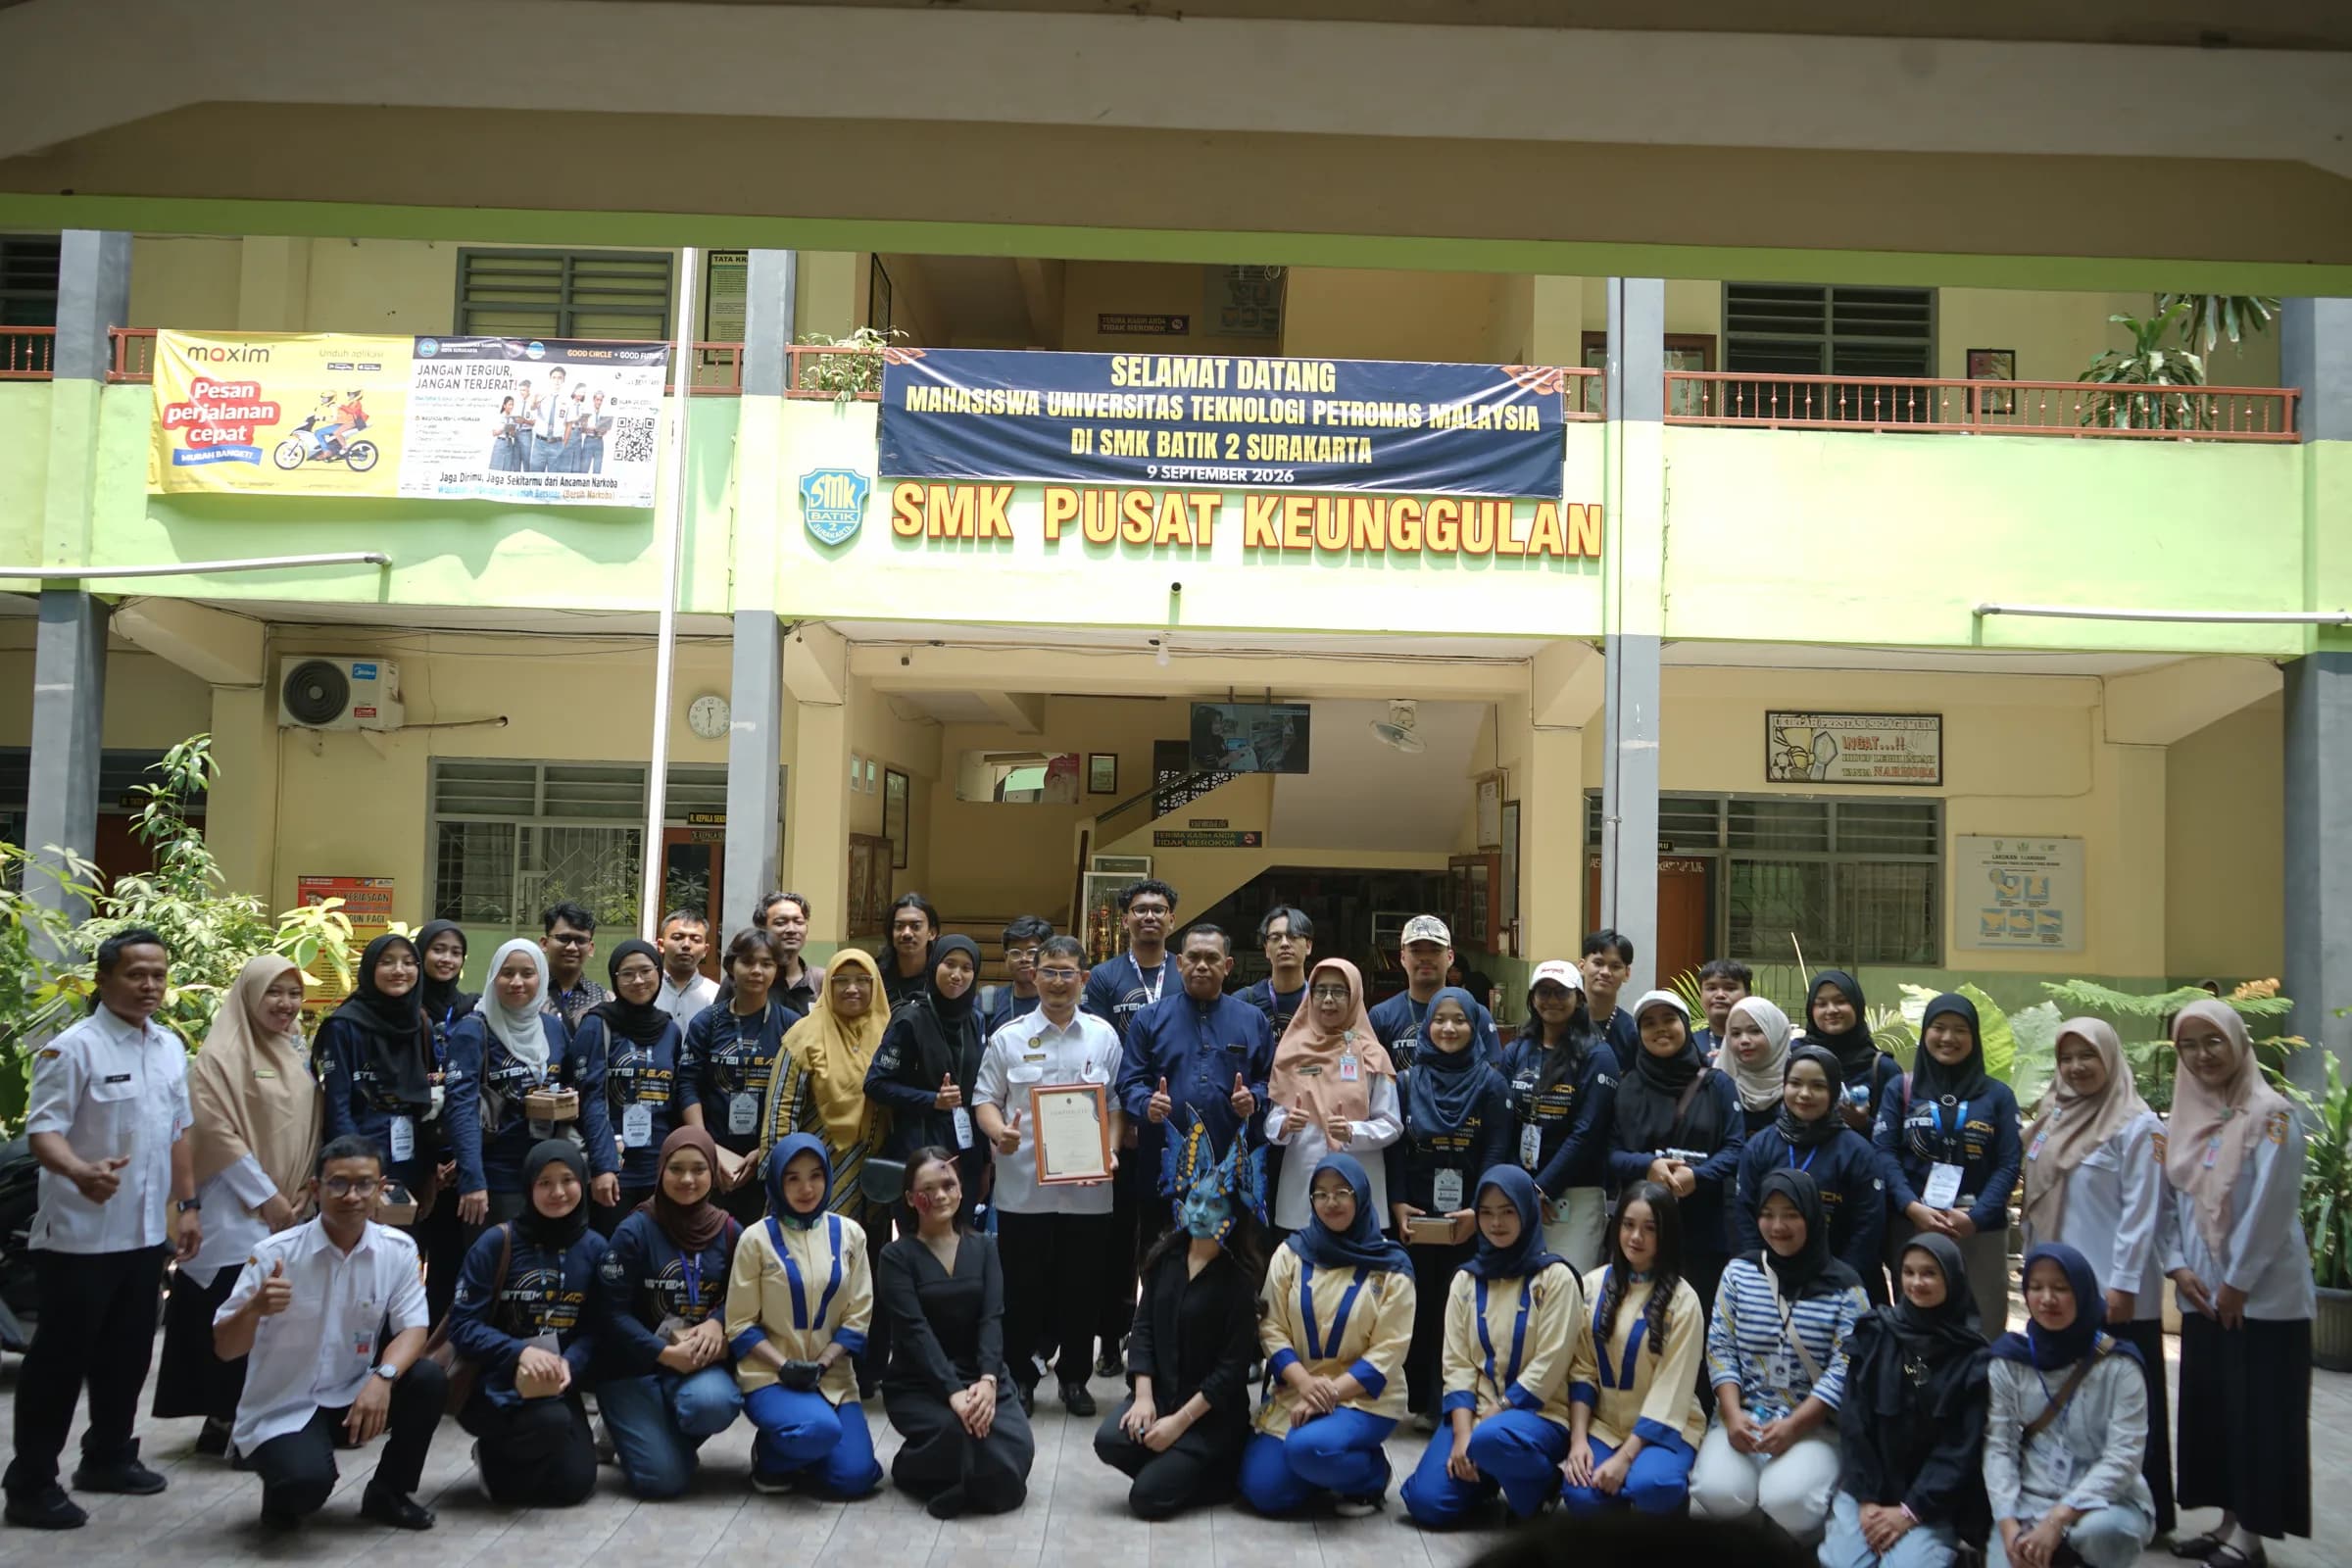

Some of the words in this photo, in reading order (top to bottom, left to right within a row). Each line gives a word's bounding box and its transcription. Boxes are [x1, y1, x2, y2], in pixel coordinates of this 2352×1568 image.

[188, 344, 270, 363] maxim
[319, 349, 348, 359] Unduh
[589, 350, 612, 359] CIRCLE
[619, 351, 640, 360] GOOD
[417, 365, 463, 376] JANGAN
[466, 365, 513, 377] TERGIUR,
[1110, 356, 1230, 391] SELAMAT
[1238, 361, 1337, 393] DATANG
[194, 382, 255, 399] Pesan
[416, 378, 461, 389] JANGAN
[464, 378, 517, 391] TERJERAT!
[168, 401, 274, 423] perjalanan
[906, 385, 1040, 416] MAHASISWA
[1047, 392, 1184, 421] UNIVERSITAS
[1191, 396, 1305, 424] TEKNOLOGI
[1312, 400, 1422, 429] PETRONAS
[1429, 404, 1540, 432] MALAYSIA
[190, 425, 247, 444] cepat
[1071, 428, 1094, 456] DI
[1100, 429, 1149, 458] SMK
[1156, 430, 1217, 460] BATIK
[1225, 432, 1240, 461] 2
[1247, 434, 1372, 464] SURAKARTA
[440, 471, 458, 483] Jaga
[460, 472, 484, 483] Dirimu,
[486, 473, 504, 485] Jaga
[507, 475, 543, 487] Sekitarmu
[544, 476, 560, 487] dari
[561, 476, 591, 488] Ancaman
[592, 477, 618, 489] Narkoba
[1147, 465, 1156, 479] 9
[1161, 465, 1248, 482] SEPTEMBER
[1251, 468, 1295, 483] 2026
[810, 474, 857, 510] SMK
[811, 512, 856, 521] BATIK
[892, 481, 1015, 539] SMK
[1044, 486, 1223, 546] PUSAT
[1244, 493, 1603, 557] KEUNGGULAN
[812, 523, 854, 539] SURAKARTA
[828, 522, 837, 531] 2
[343, 892, 389, 903] KEBIASAAN
[489, 1066, 529, 1081] STEM
